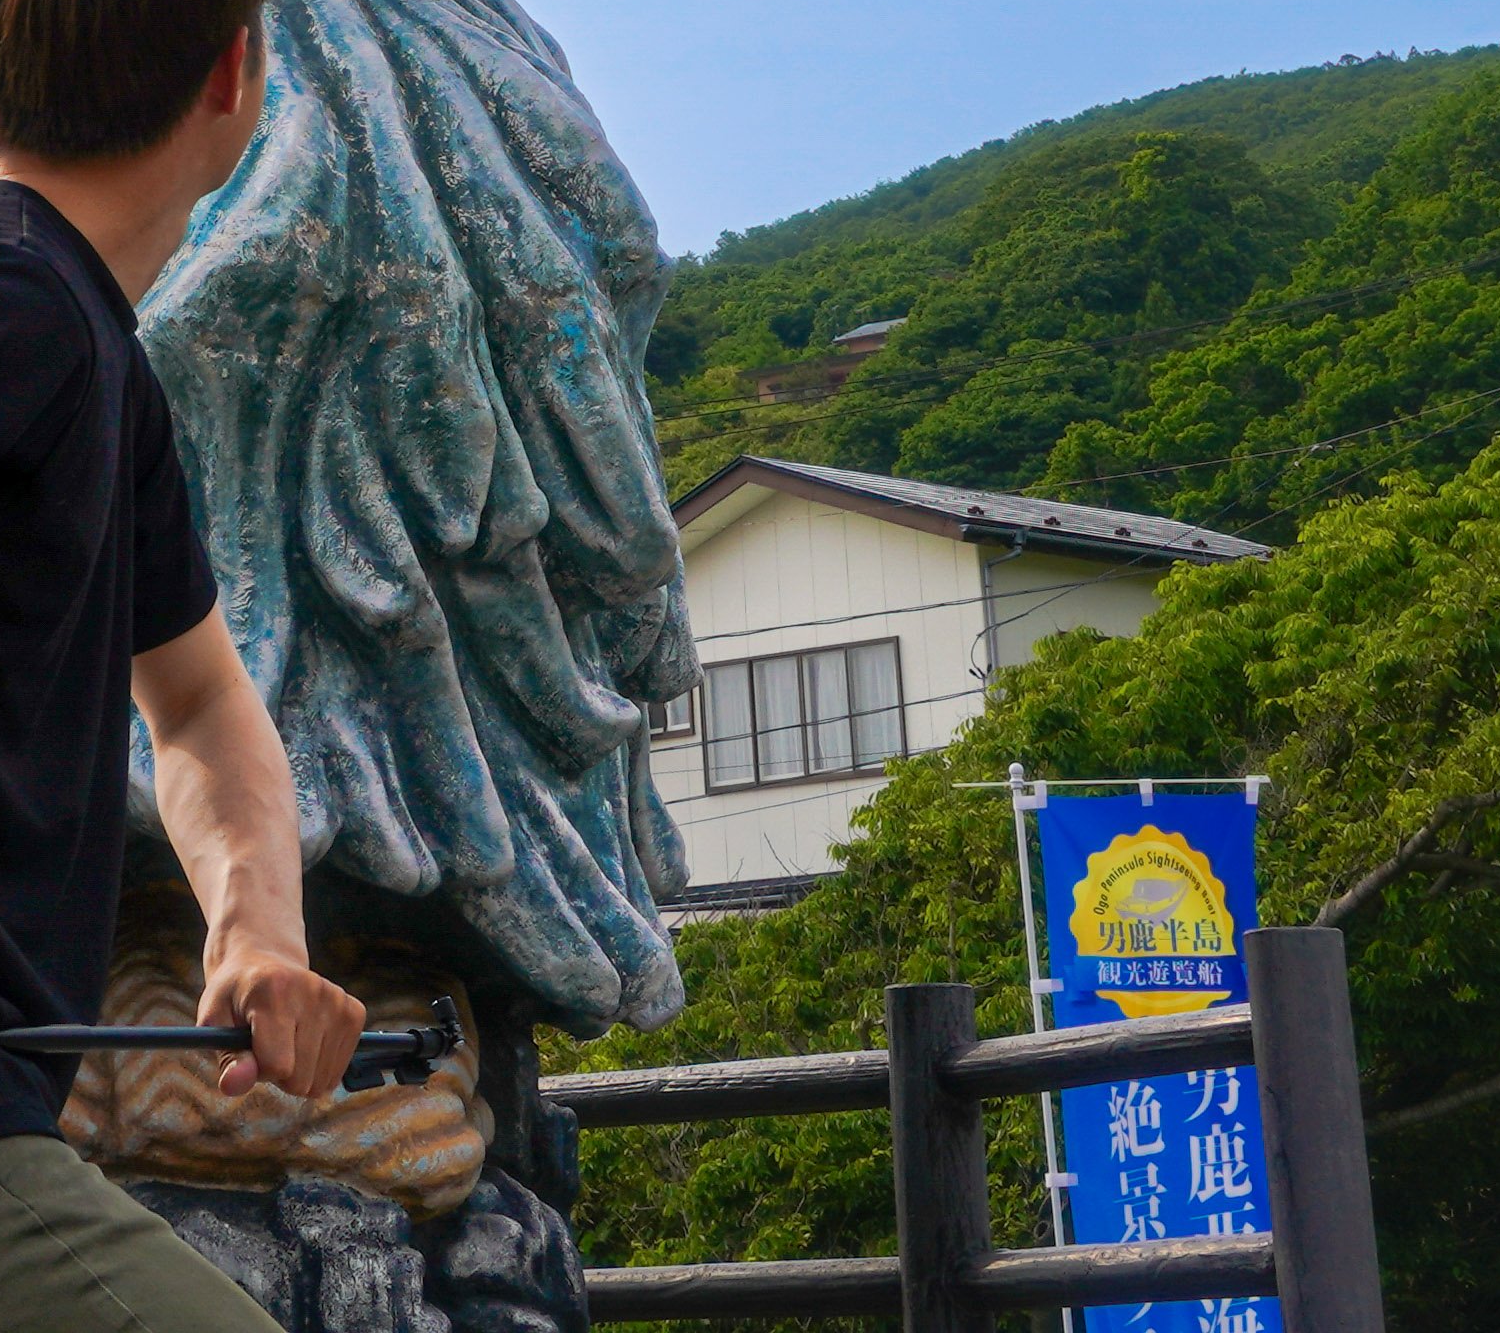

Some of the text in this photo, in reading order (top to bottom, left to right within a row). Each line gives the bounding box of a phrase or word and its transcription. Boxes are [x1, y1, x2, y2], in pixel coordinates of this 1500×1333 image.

[1100, 854, 1145, 893] Peninsula
[1146, 851, 1202, 892] Sightseeing
[1098, 918, 1223, 954] 男鹿半島
[1097, 960, 1224, 986] 観光遊覧船
